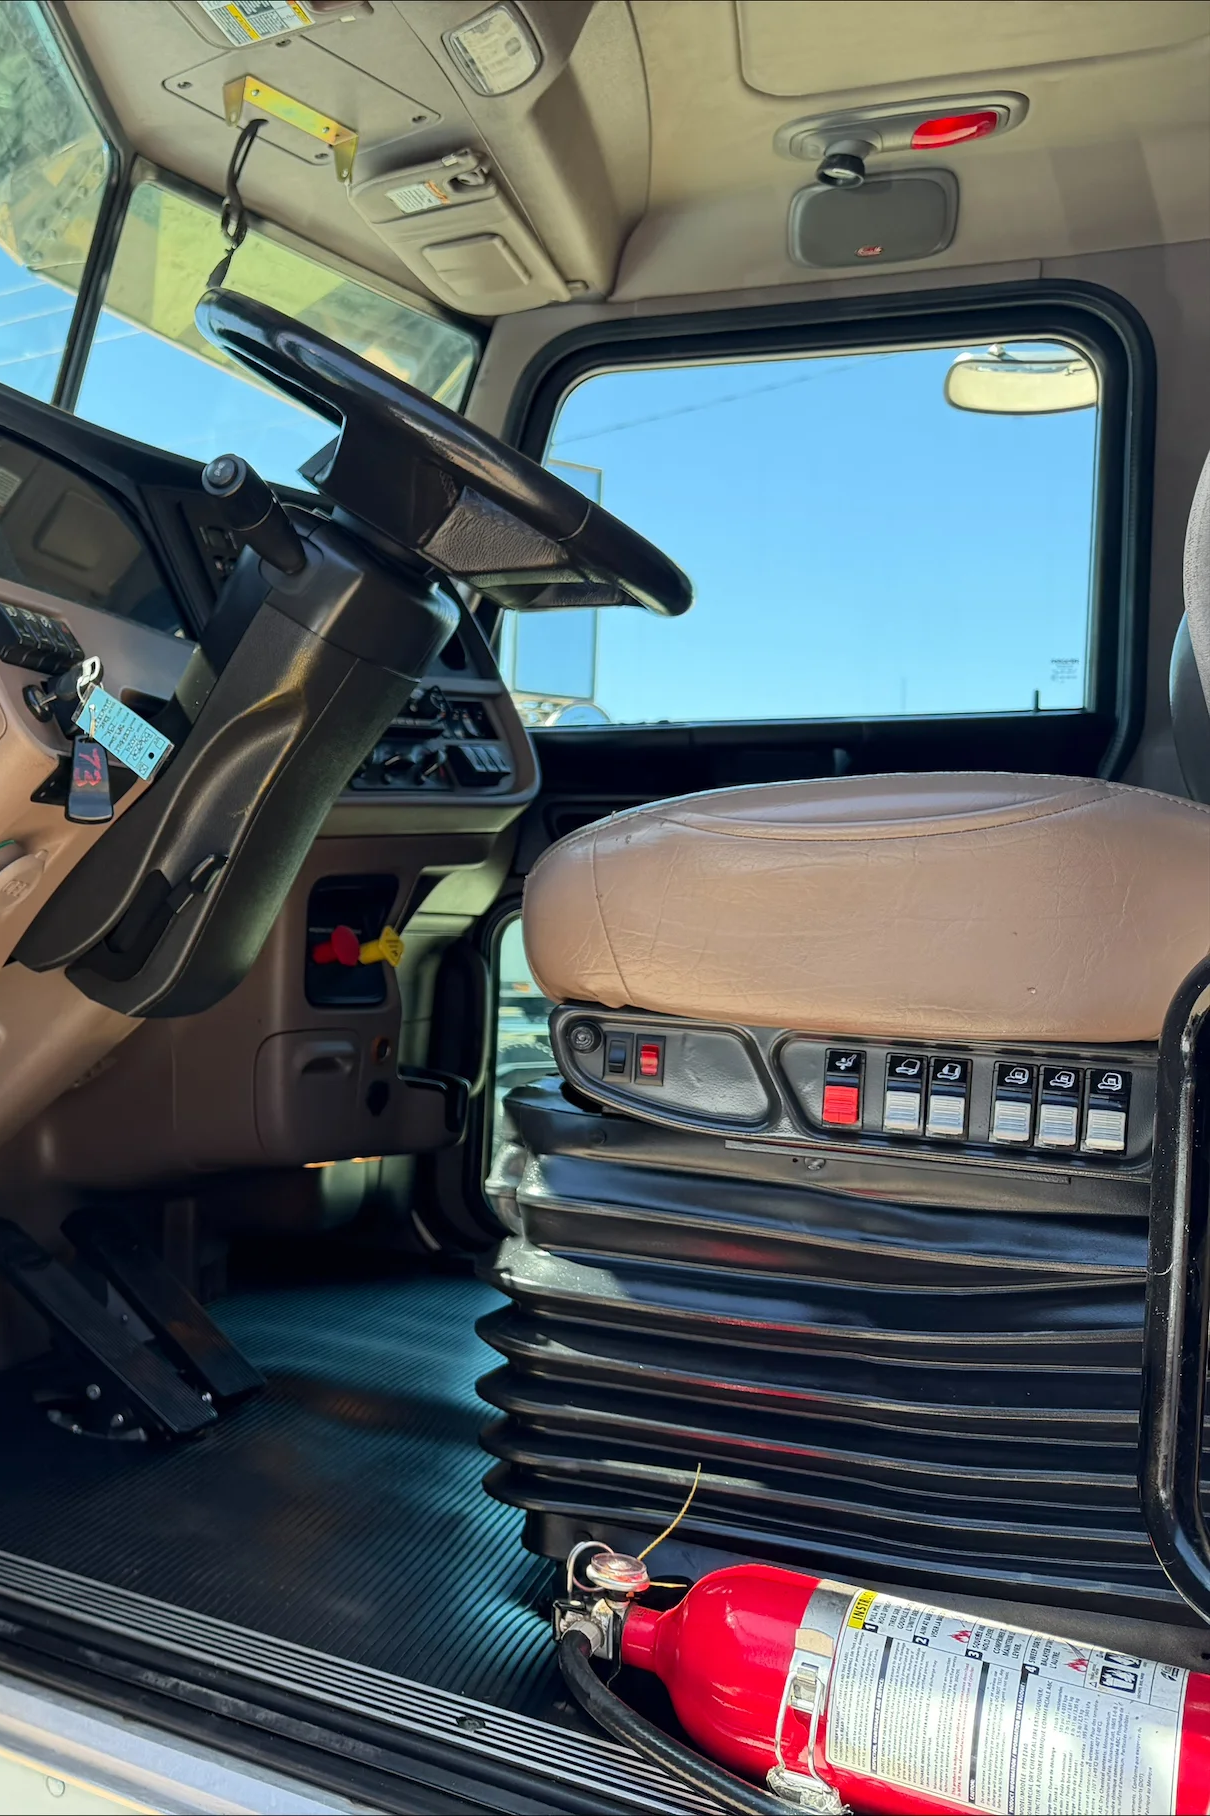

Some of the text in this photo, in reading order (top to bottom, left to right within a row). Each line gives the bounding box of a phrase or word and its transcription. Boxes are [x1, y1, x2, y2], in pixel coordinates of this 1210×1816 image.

[916, 1636, 927, 1644] 2
[968, 1650, 979, 1658] 3
[1035, 1759, 1043, 1783] POUDRE
[1040, 1690, 1051, 1729] COMMERCIALE
